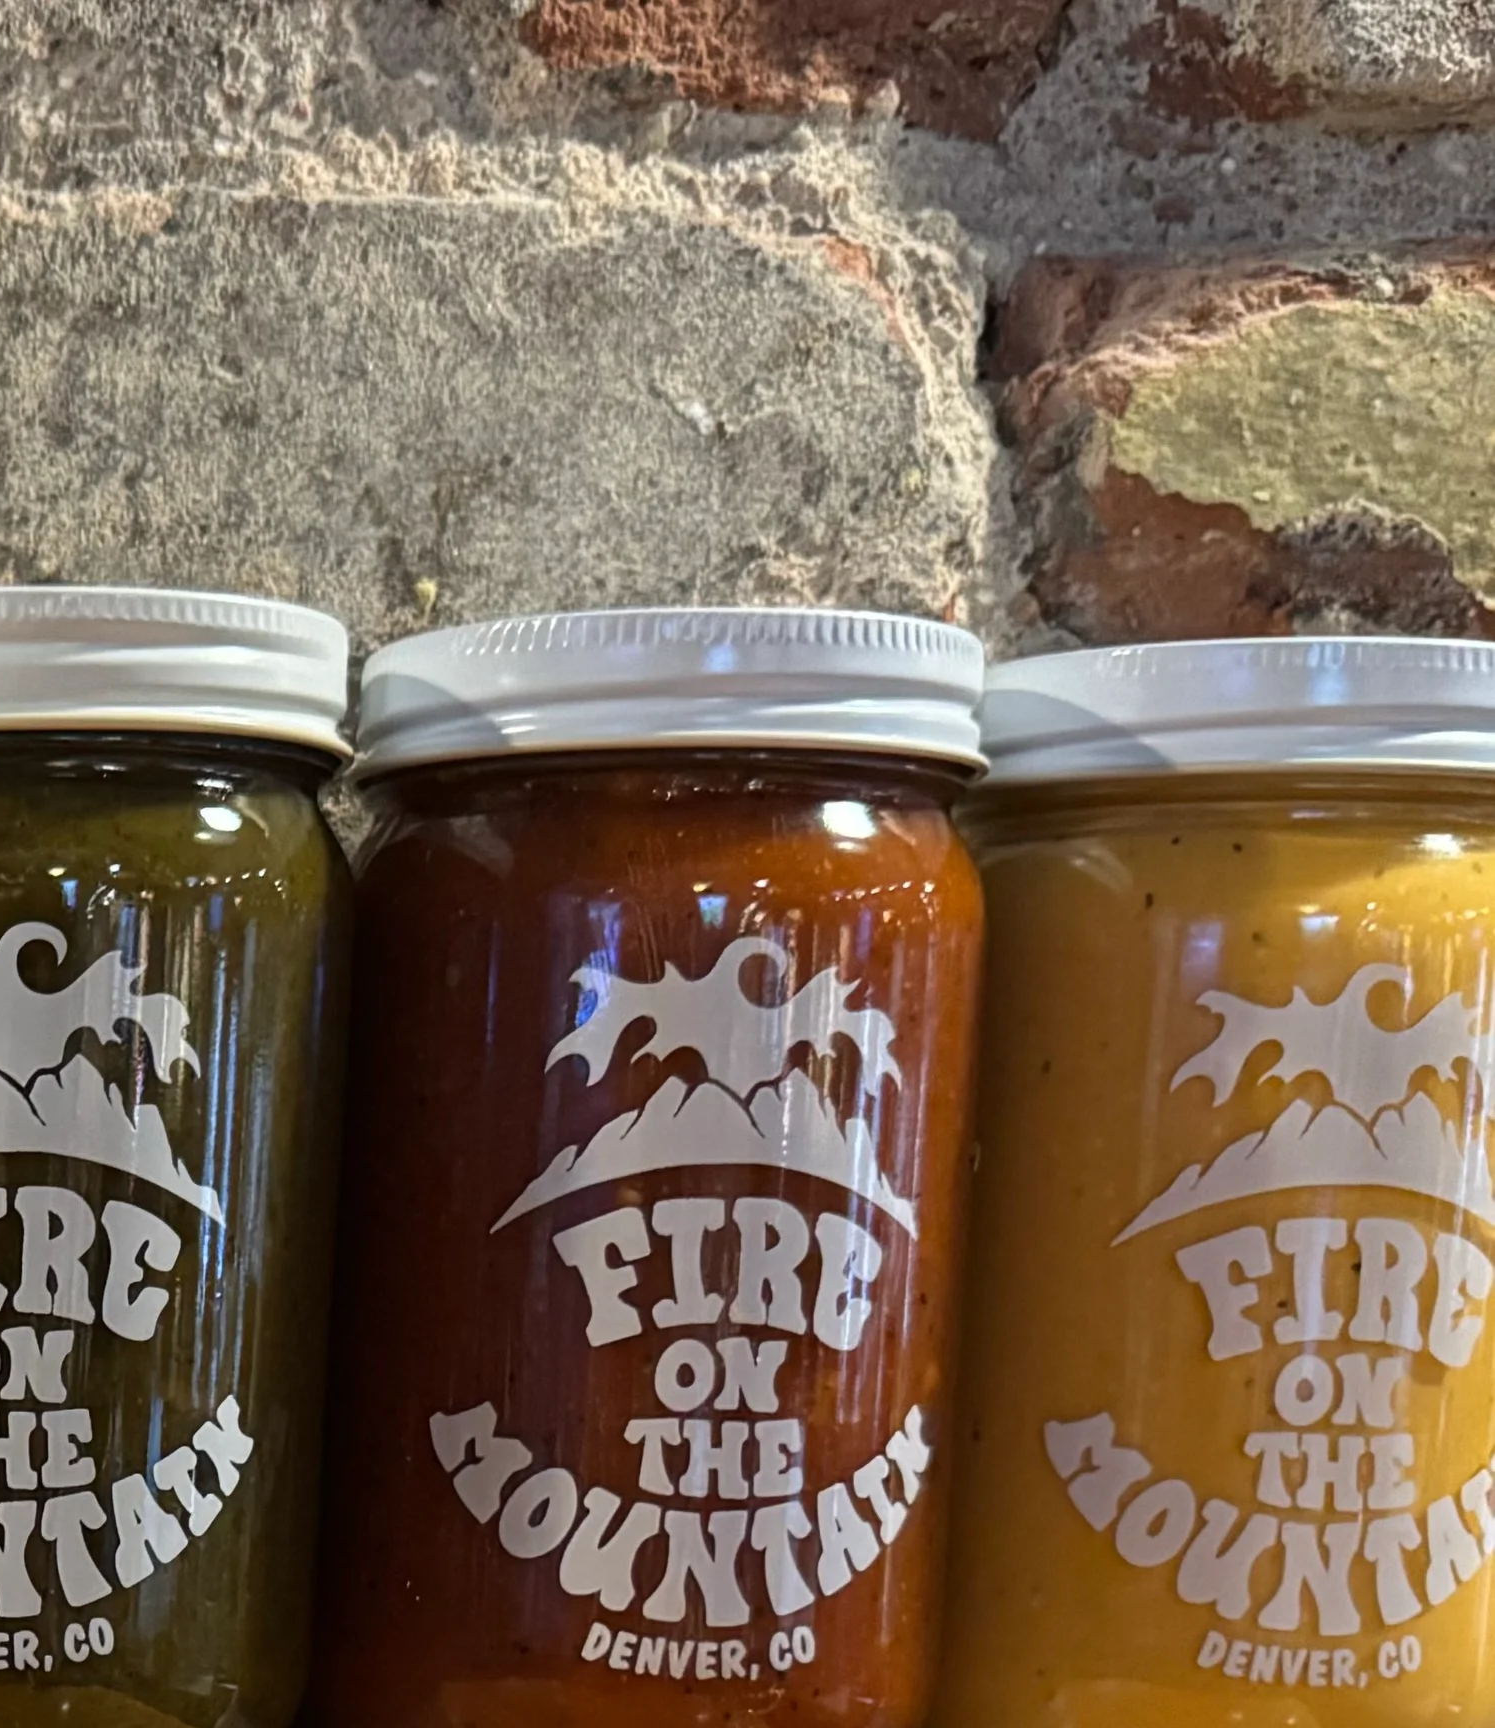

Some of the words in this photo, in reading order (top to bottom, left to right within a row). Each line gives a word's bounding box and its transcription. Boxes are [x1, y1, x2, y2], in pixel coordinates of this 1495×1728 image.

[553, 1197, 882, 1351] FIRE
[1176, 1217, 1489, 1369] FIRE
[655, 1338, 787, 1413] ON
[1272, 1355, 1404, 1431] ON
[625, 1416, 802, 1500] THE
[1244, 1430, 1414, 1512] THE
[429, 1399, 932, 1629] MOUNTAIN
[1045, 1410, 1495, 1636] MOUNTAI
[64, 1617, 114, 1660] CO
[582, 1622, 760, 1682] DENVER,
[769, 1626, 816, 1671] CO
[1197, 1631, 1370, 1691] DENVER,
[1378, 1635, 1421, 1678] CO
